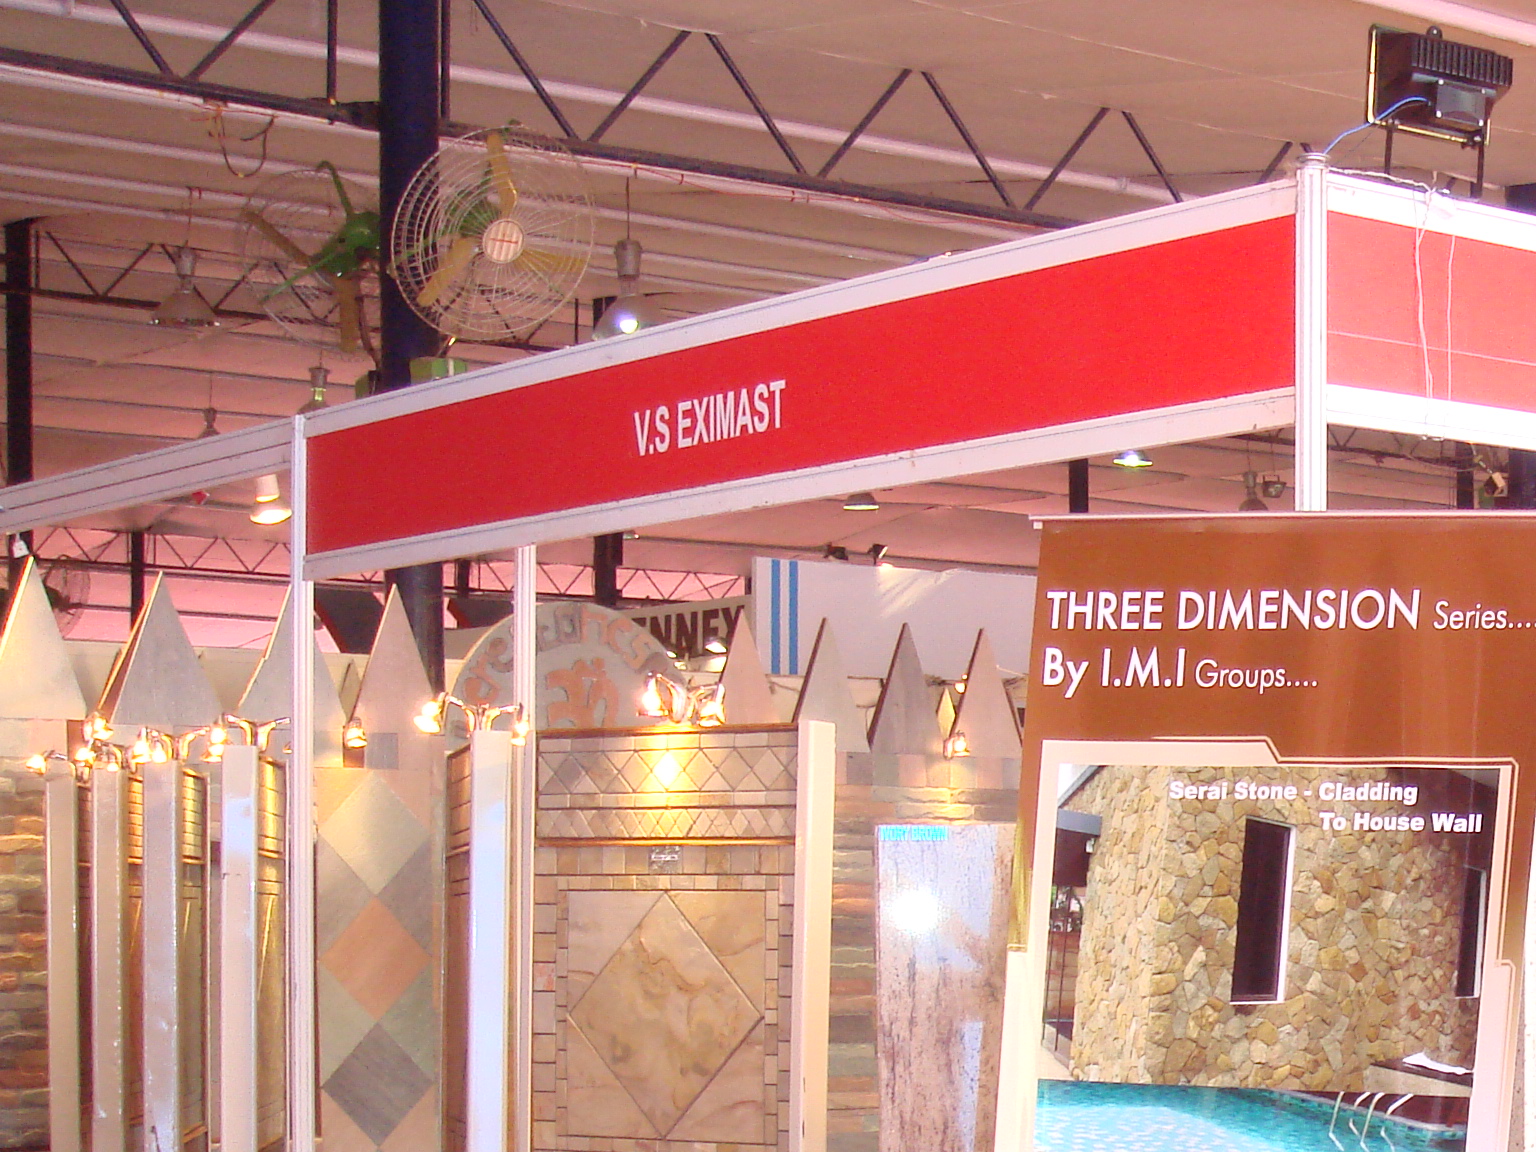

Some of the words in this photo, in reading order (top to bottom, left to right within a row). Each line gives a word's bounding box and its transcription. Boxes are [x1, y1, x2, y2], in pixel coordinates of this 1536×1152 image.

[634, 405, 670, 456] V.S
[678, 379, 786, 449] EXIMAST
[1046, 590, 1165, 630] THREE
[1177, 587, 1421, 631] DIMENSION
[1042, 647, 1090, 699] By
[1101, 646, 1187, 688] I.M.I
[1168, 780, 1228, 801] Serai
[1233, 781, 1298, 801] Stone
[1318, 781, 1419, 807] Cladding
[910, 824, 949, 842] BROWN
[1319, 812, 1347, 832] To
[1352, 812, 1425, 833] House
[1431, 812, 1483, 833] Wall
